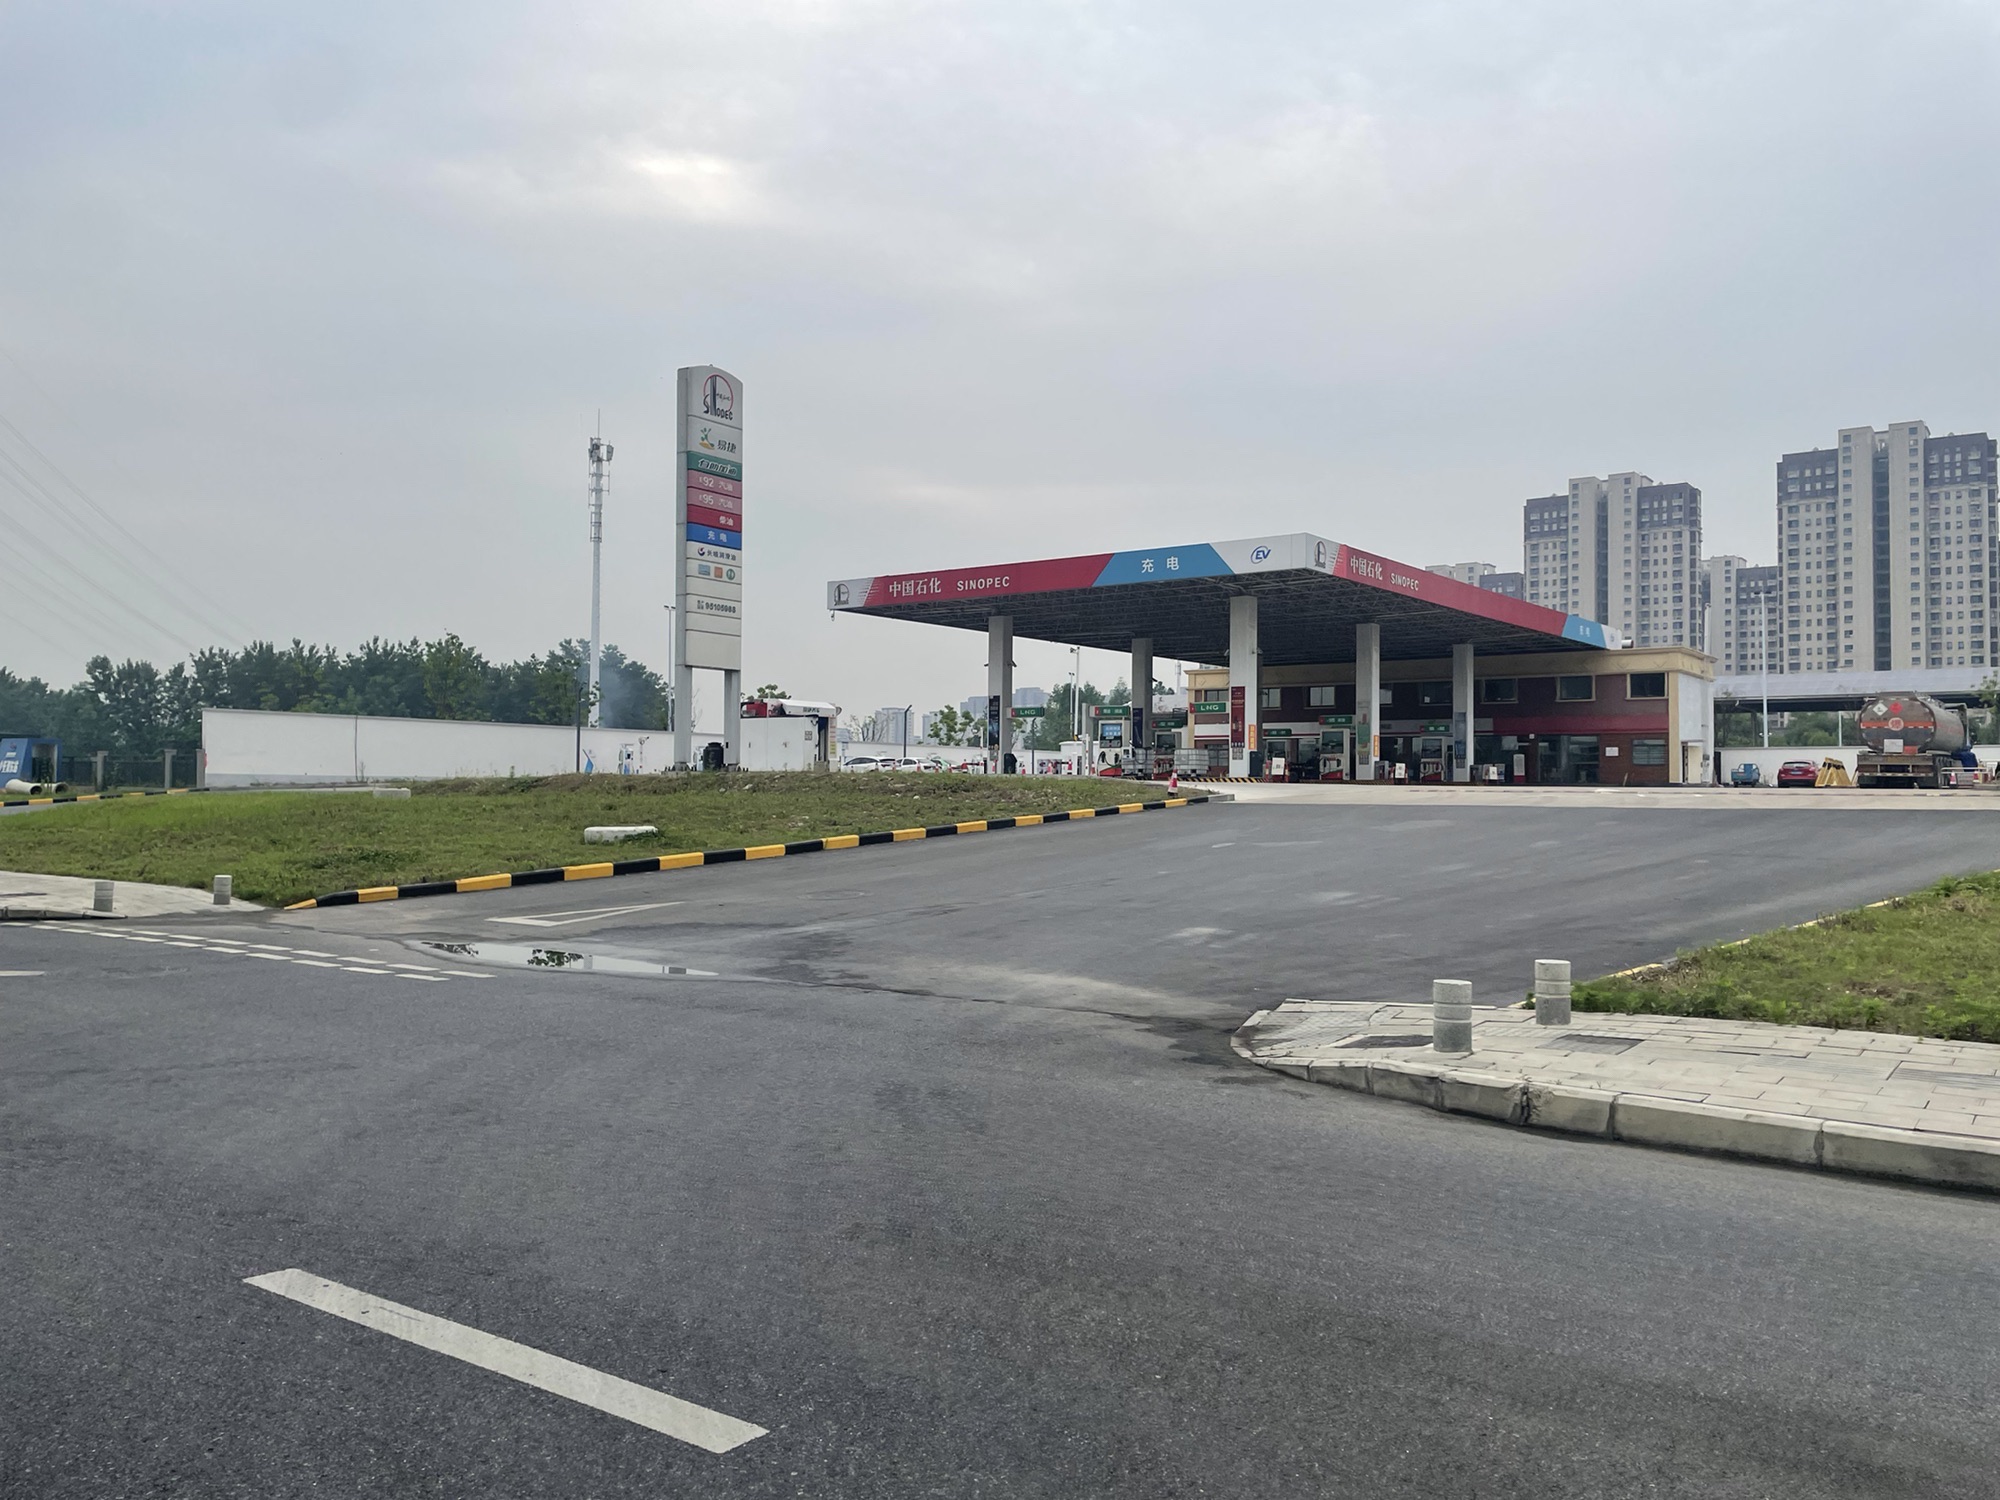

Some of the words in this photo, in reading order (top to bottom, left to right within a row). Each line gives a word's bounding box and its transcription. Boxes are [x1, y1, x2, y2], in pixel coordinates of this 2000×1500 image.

[1141, 555, 1180, 573] 充电
[1349, 553, 1383, 582] 中国石化
[1390, 571, 1420, 591] SINOPEC
[888, 577, 942, 599] 中国石化
[956, 575, 1011, 592] SINOPEC
[1200, 703, 1219, 712] LNG
